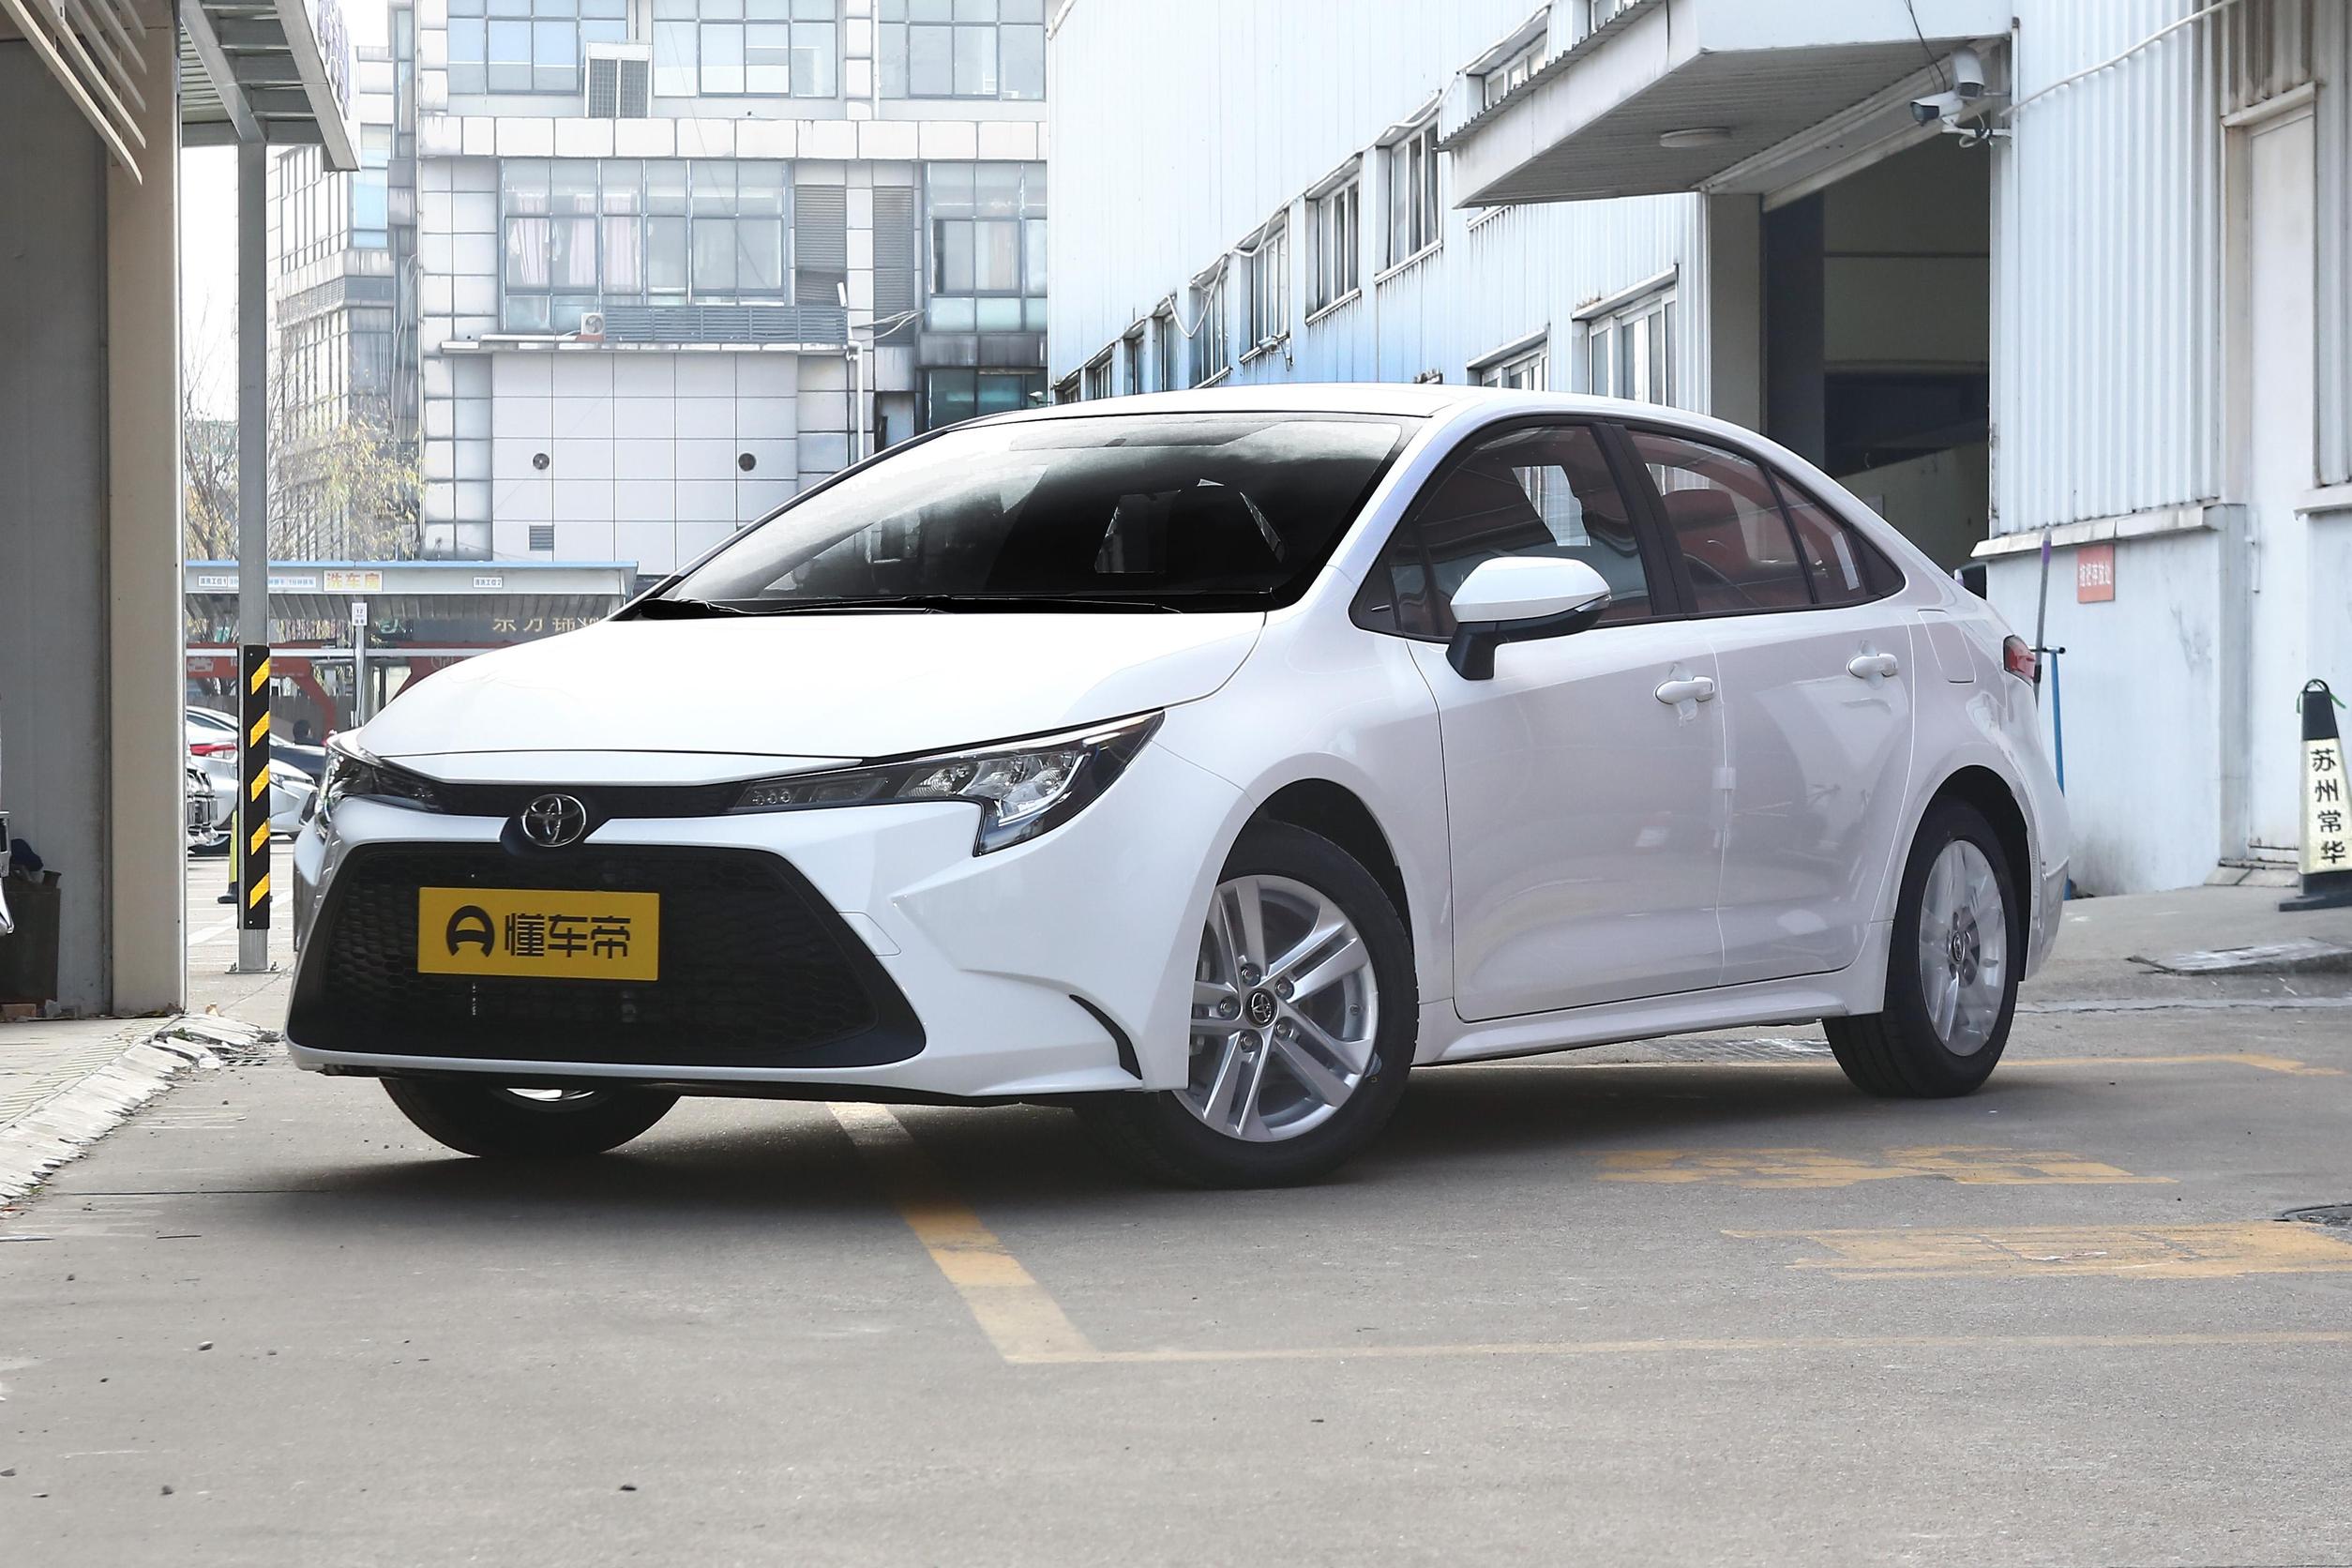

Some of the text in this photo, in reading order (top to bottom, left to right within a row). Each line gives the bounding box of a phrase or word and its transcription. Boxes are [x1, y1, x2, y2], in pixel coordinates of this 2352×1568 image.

[2310, 748, 2346, 864] 苏州常华
[505, 912, 631, 958] 懂车帝
